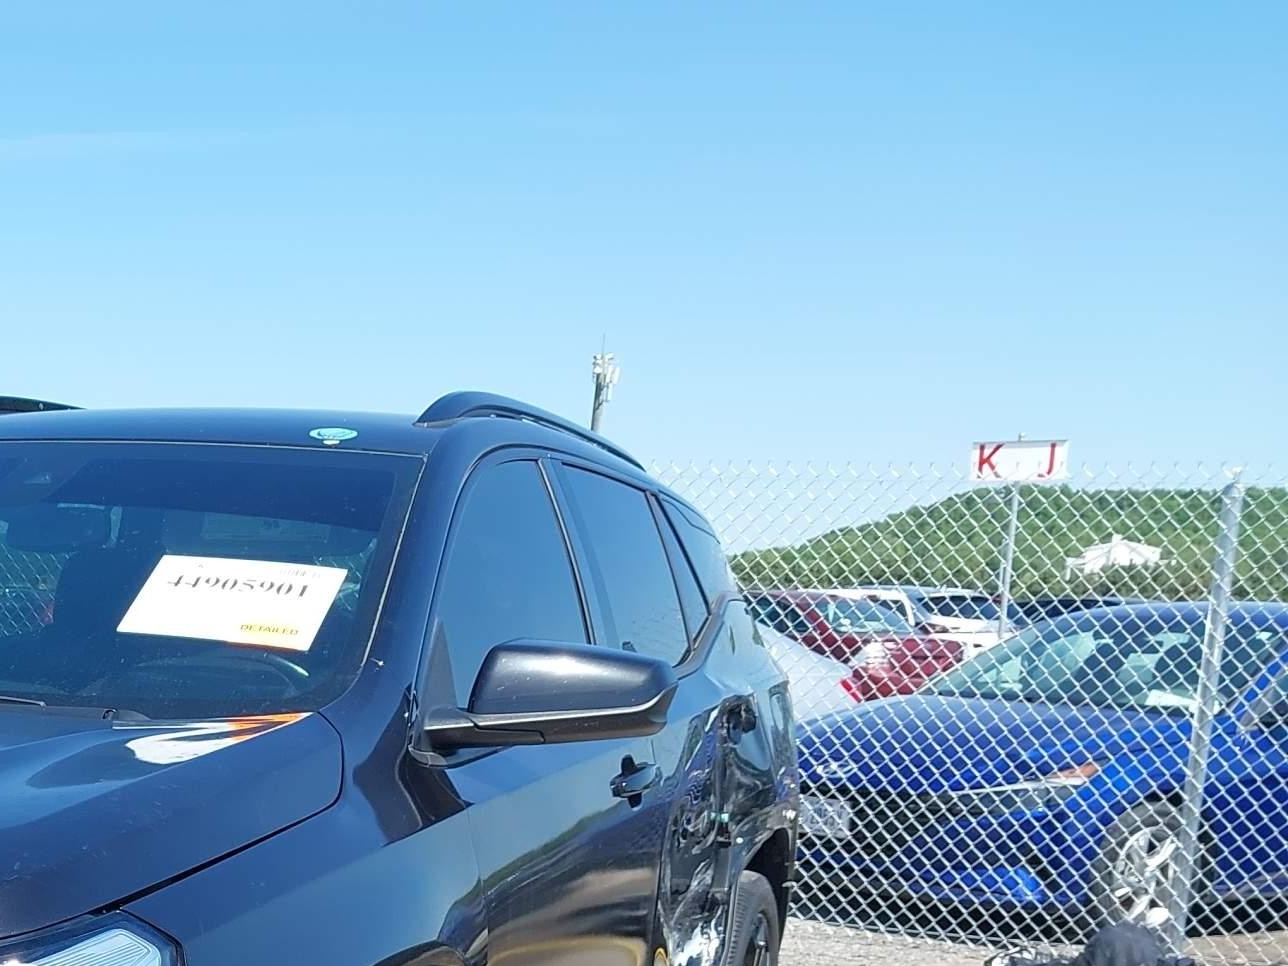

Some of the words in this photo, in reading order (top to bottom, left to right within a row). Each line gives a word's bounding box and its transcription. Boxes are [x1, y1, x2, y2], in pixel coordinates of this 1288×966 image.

[976, 442, 1005, 479] K
[1037, 442, 1057, 478] J
[167, 573, 309, 599] 44905901
[239, 623, 299, 637] DETAILED
